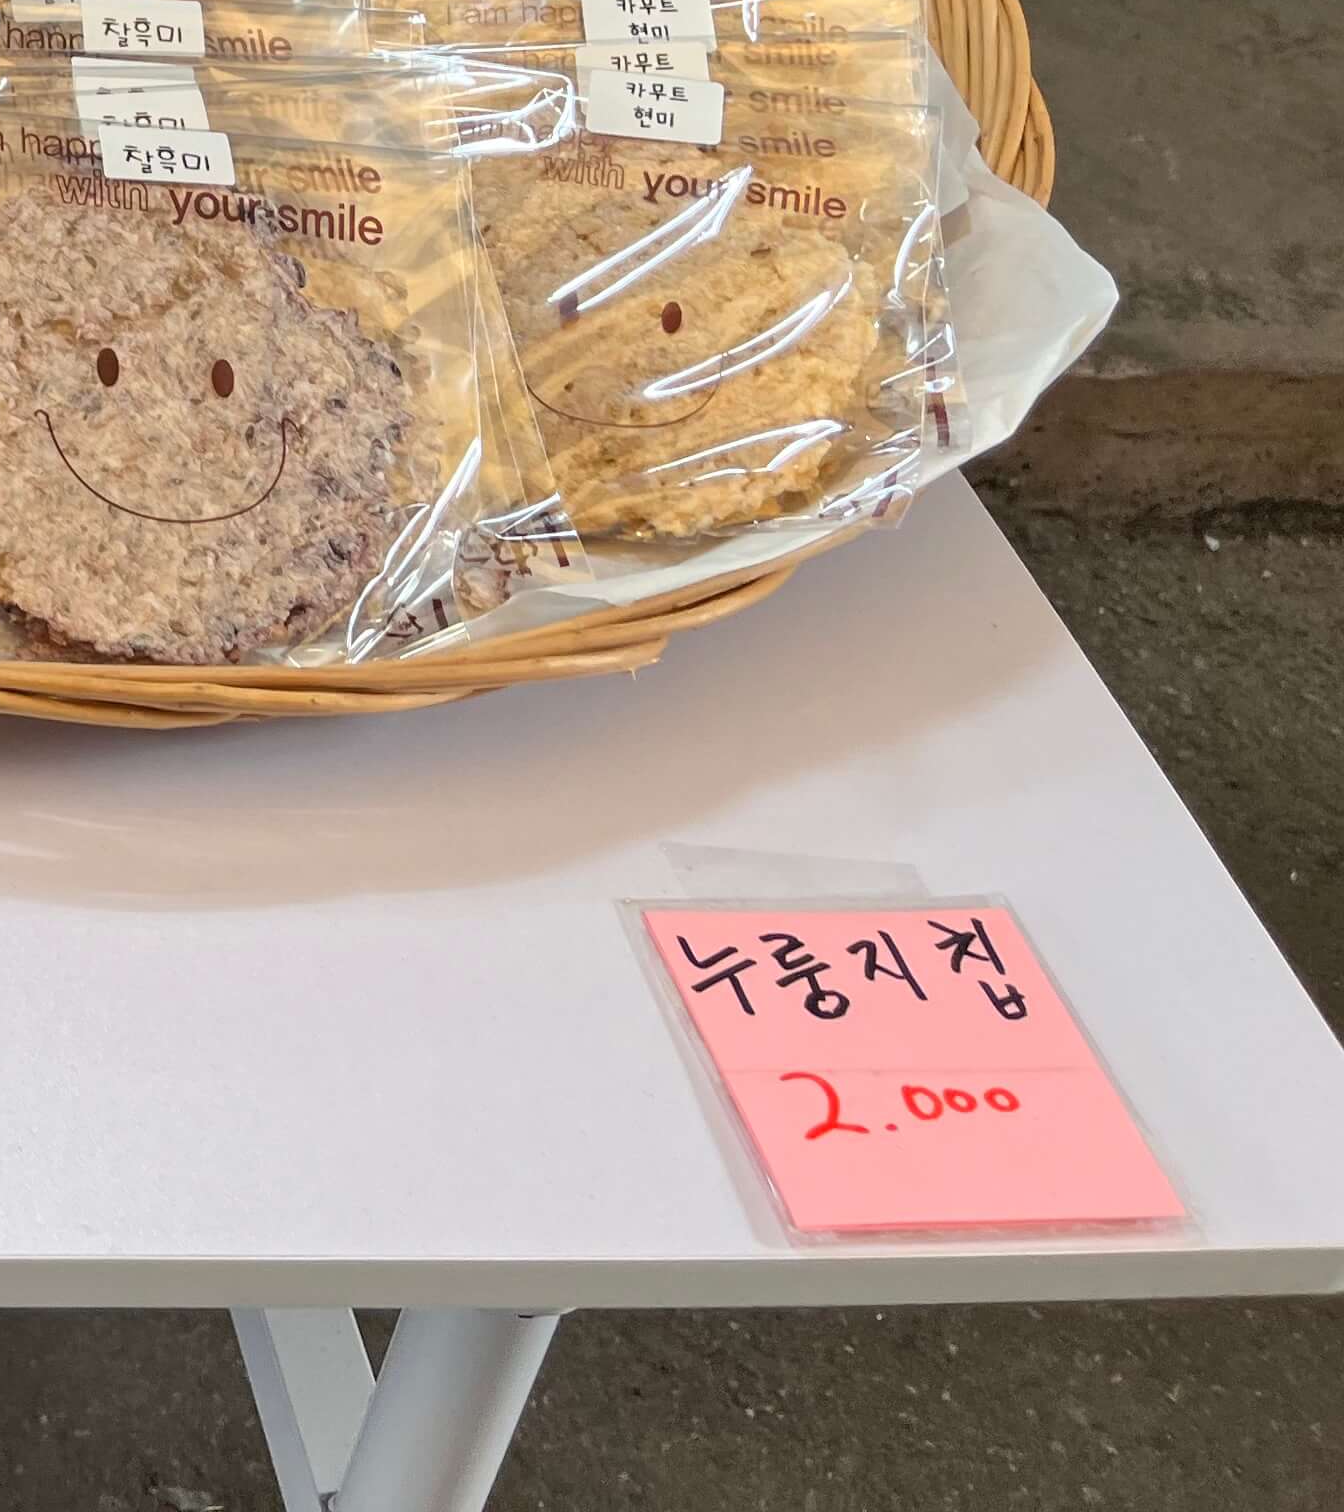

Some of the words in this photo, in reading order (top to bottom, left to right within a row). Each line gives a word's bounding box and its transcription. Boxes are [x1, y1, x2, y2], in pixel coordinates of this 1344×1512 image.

[102, 17, 182, 47] 찰흑미
[628, 22, 669, 44] 현미
[610, 53, 675, 73] 카무트
[625, 81, 690, 103] 카무트
[633, 106, 676, 130] 현미
[738, 133, 837, 158] smile
[123, 145, 210, 174] 찰흑미
[543, 152, 625, 189] with
[745, 178, 847, 219] smile
[55, 169, 148, 212] with
[170, 189, 262, 226] your
[279, 203, 383, 245] smile
[780, 1070, 1021, 1142] 2.000
